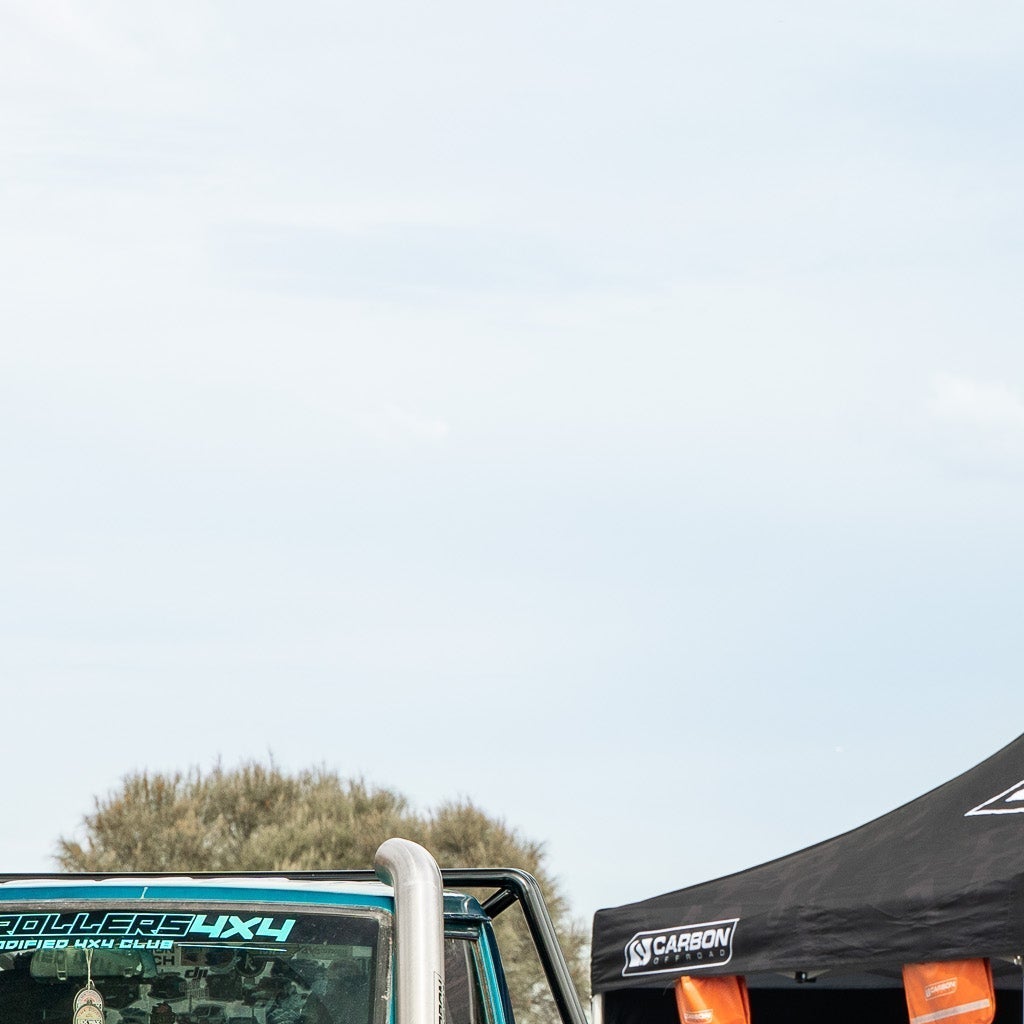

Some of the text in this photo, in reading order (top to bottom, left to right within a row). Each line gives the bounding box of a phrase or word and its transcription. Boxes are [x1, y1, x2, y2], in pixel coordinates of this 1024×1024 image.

[74, 939, 116, 950] 4X4
[119, 939, 175, 950] CLUB
[653, 927, 731, 955] CARBON
[653, 949, 726, 965] OFFROAD
